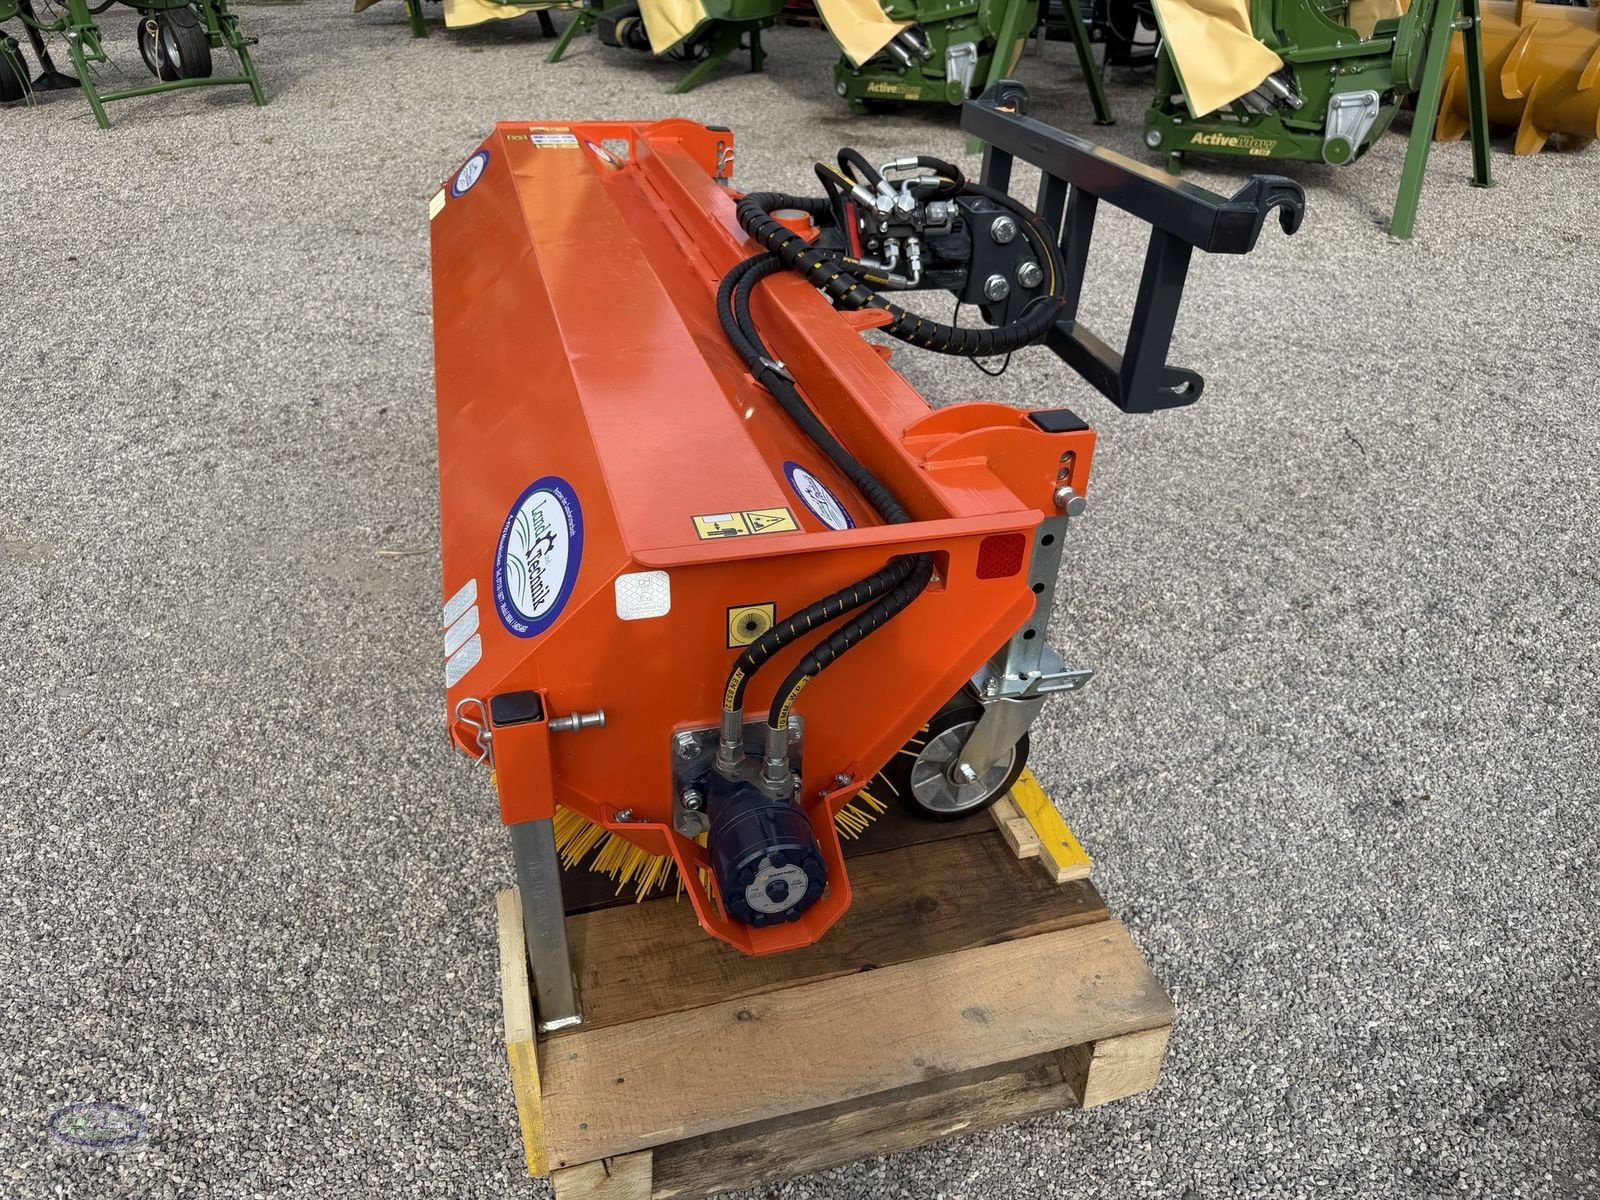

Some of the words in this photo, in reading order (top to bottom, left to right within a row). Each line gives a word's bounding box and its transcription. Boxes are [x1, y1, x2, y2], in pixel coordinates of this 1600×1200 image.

[1190, 132, 1278, 150] ActiveMow
[531, 499, 551, 538] Land
[527, 548, 550, 611] Technik
[730, 678, 740, 690] EN
